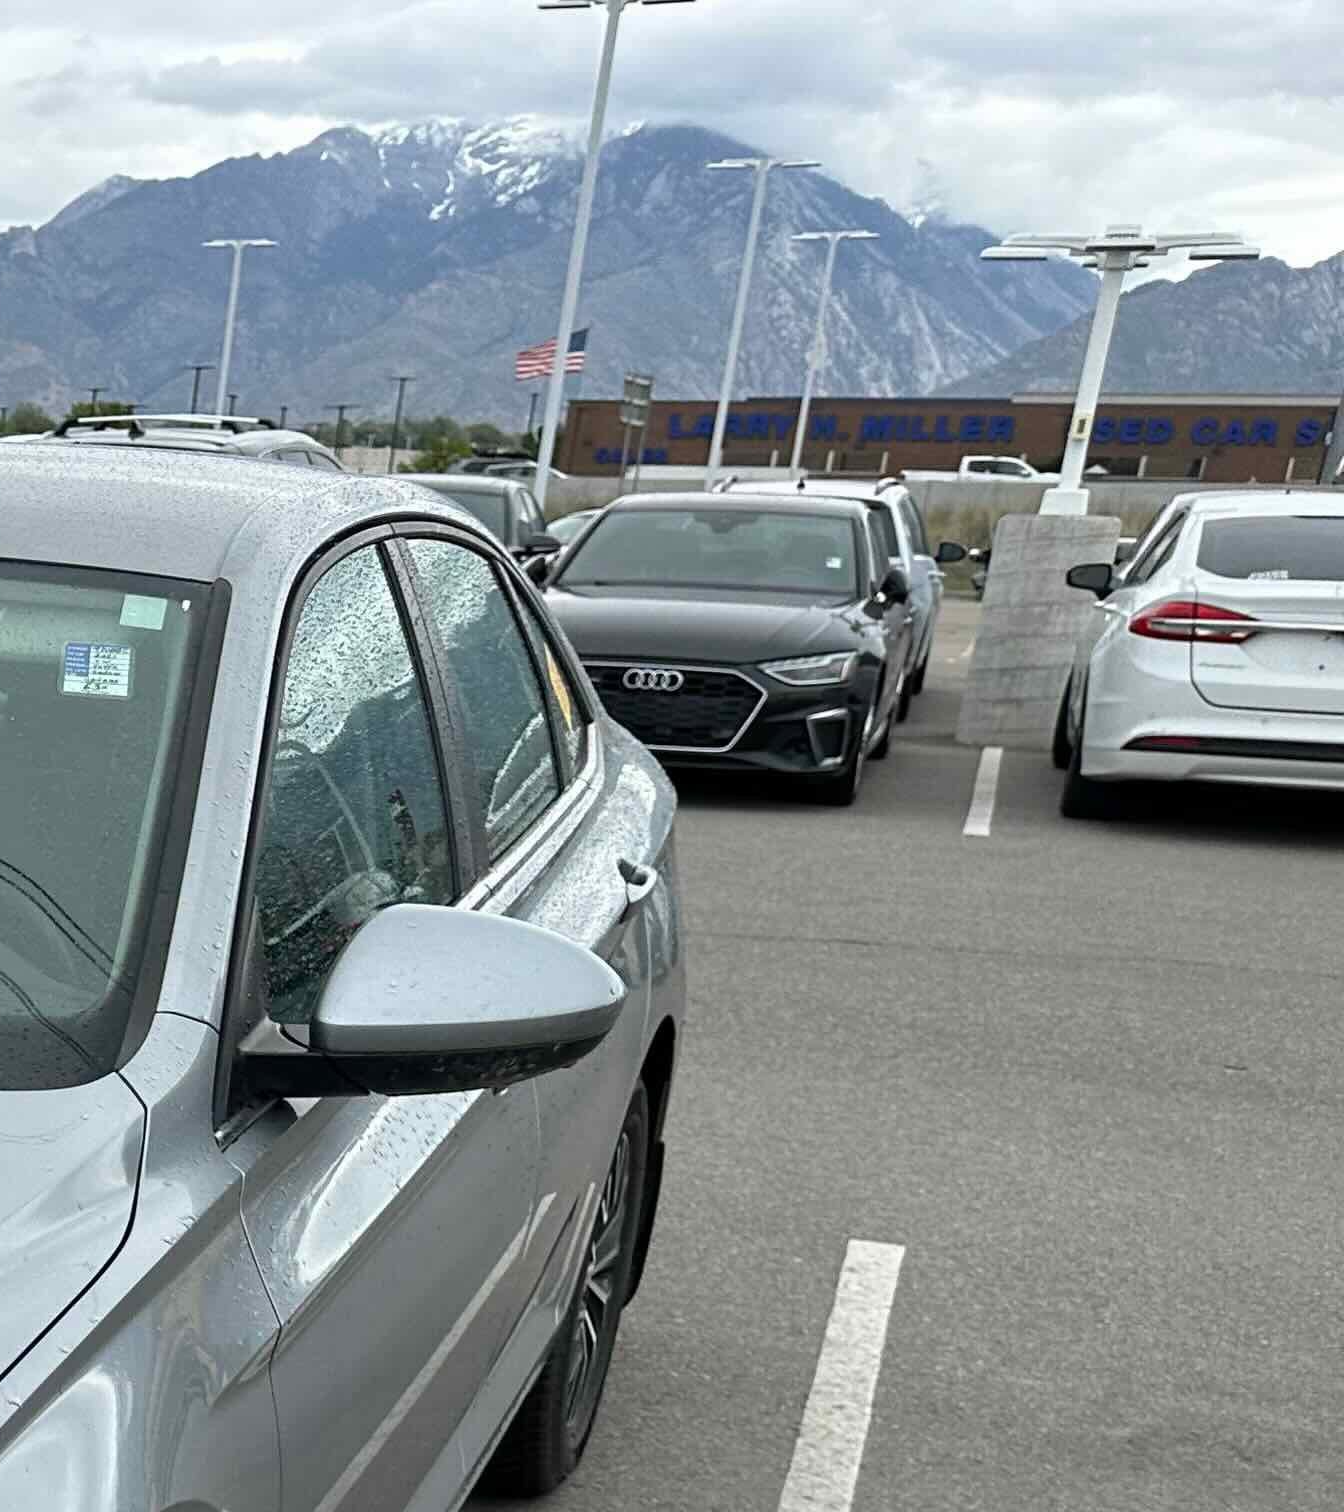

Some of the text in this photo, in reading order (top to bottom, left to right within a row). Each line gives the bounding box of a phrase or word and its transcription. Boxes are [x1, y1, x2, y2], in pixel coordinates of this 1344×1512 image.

[860, 415, 1014, 442] MILLER
[1091, 416, 1173, 445] SED
[1191, 416, 1278, 446] CAR
